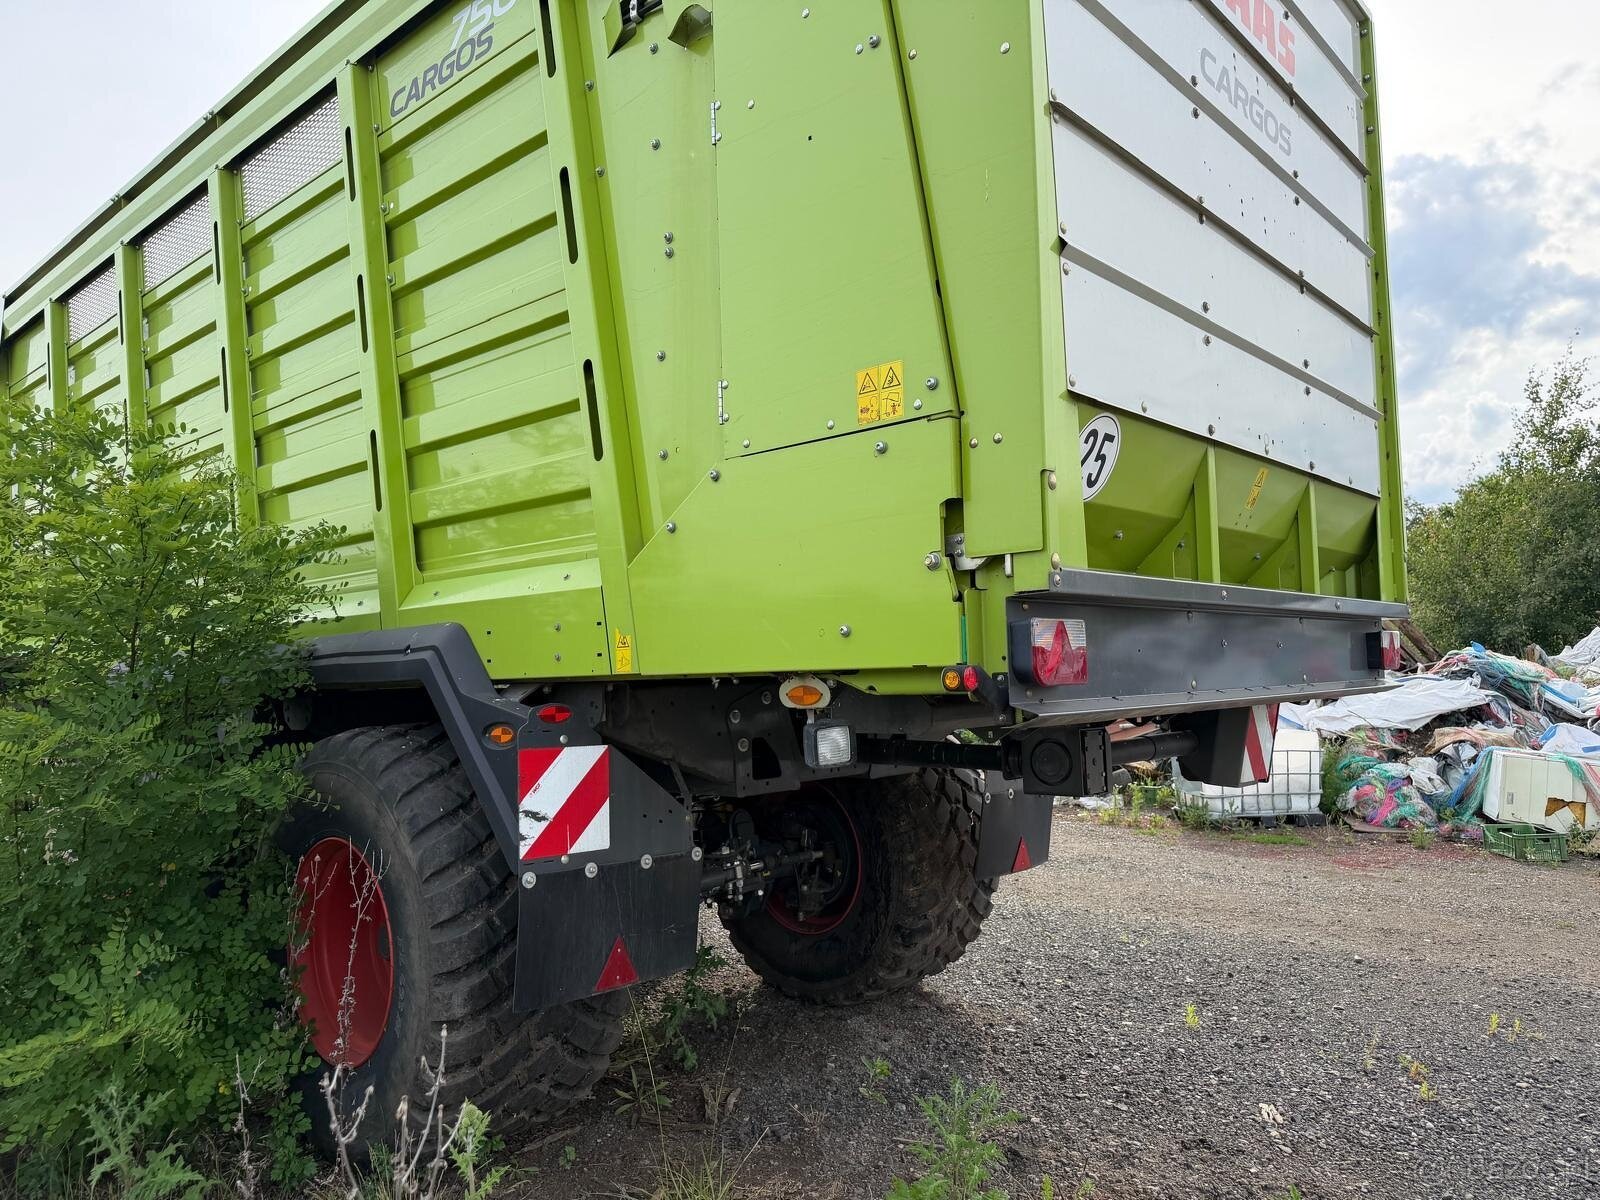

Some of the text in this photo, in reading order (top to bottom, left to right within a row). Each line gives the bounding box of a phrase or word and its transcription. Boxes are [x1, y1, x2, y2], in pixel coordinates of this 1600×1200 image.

[390, 22, 495, 118] CARGOS
[1200, 47, 1292, 157] CARGOS
[1081, 428, 1116, 489] 25
